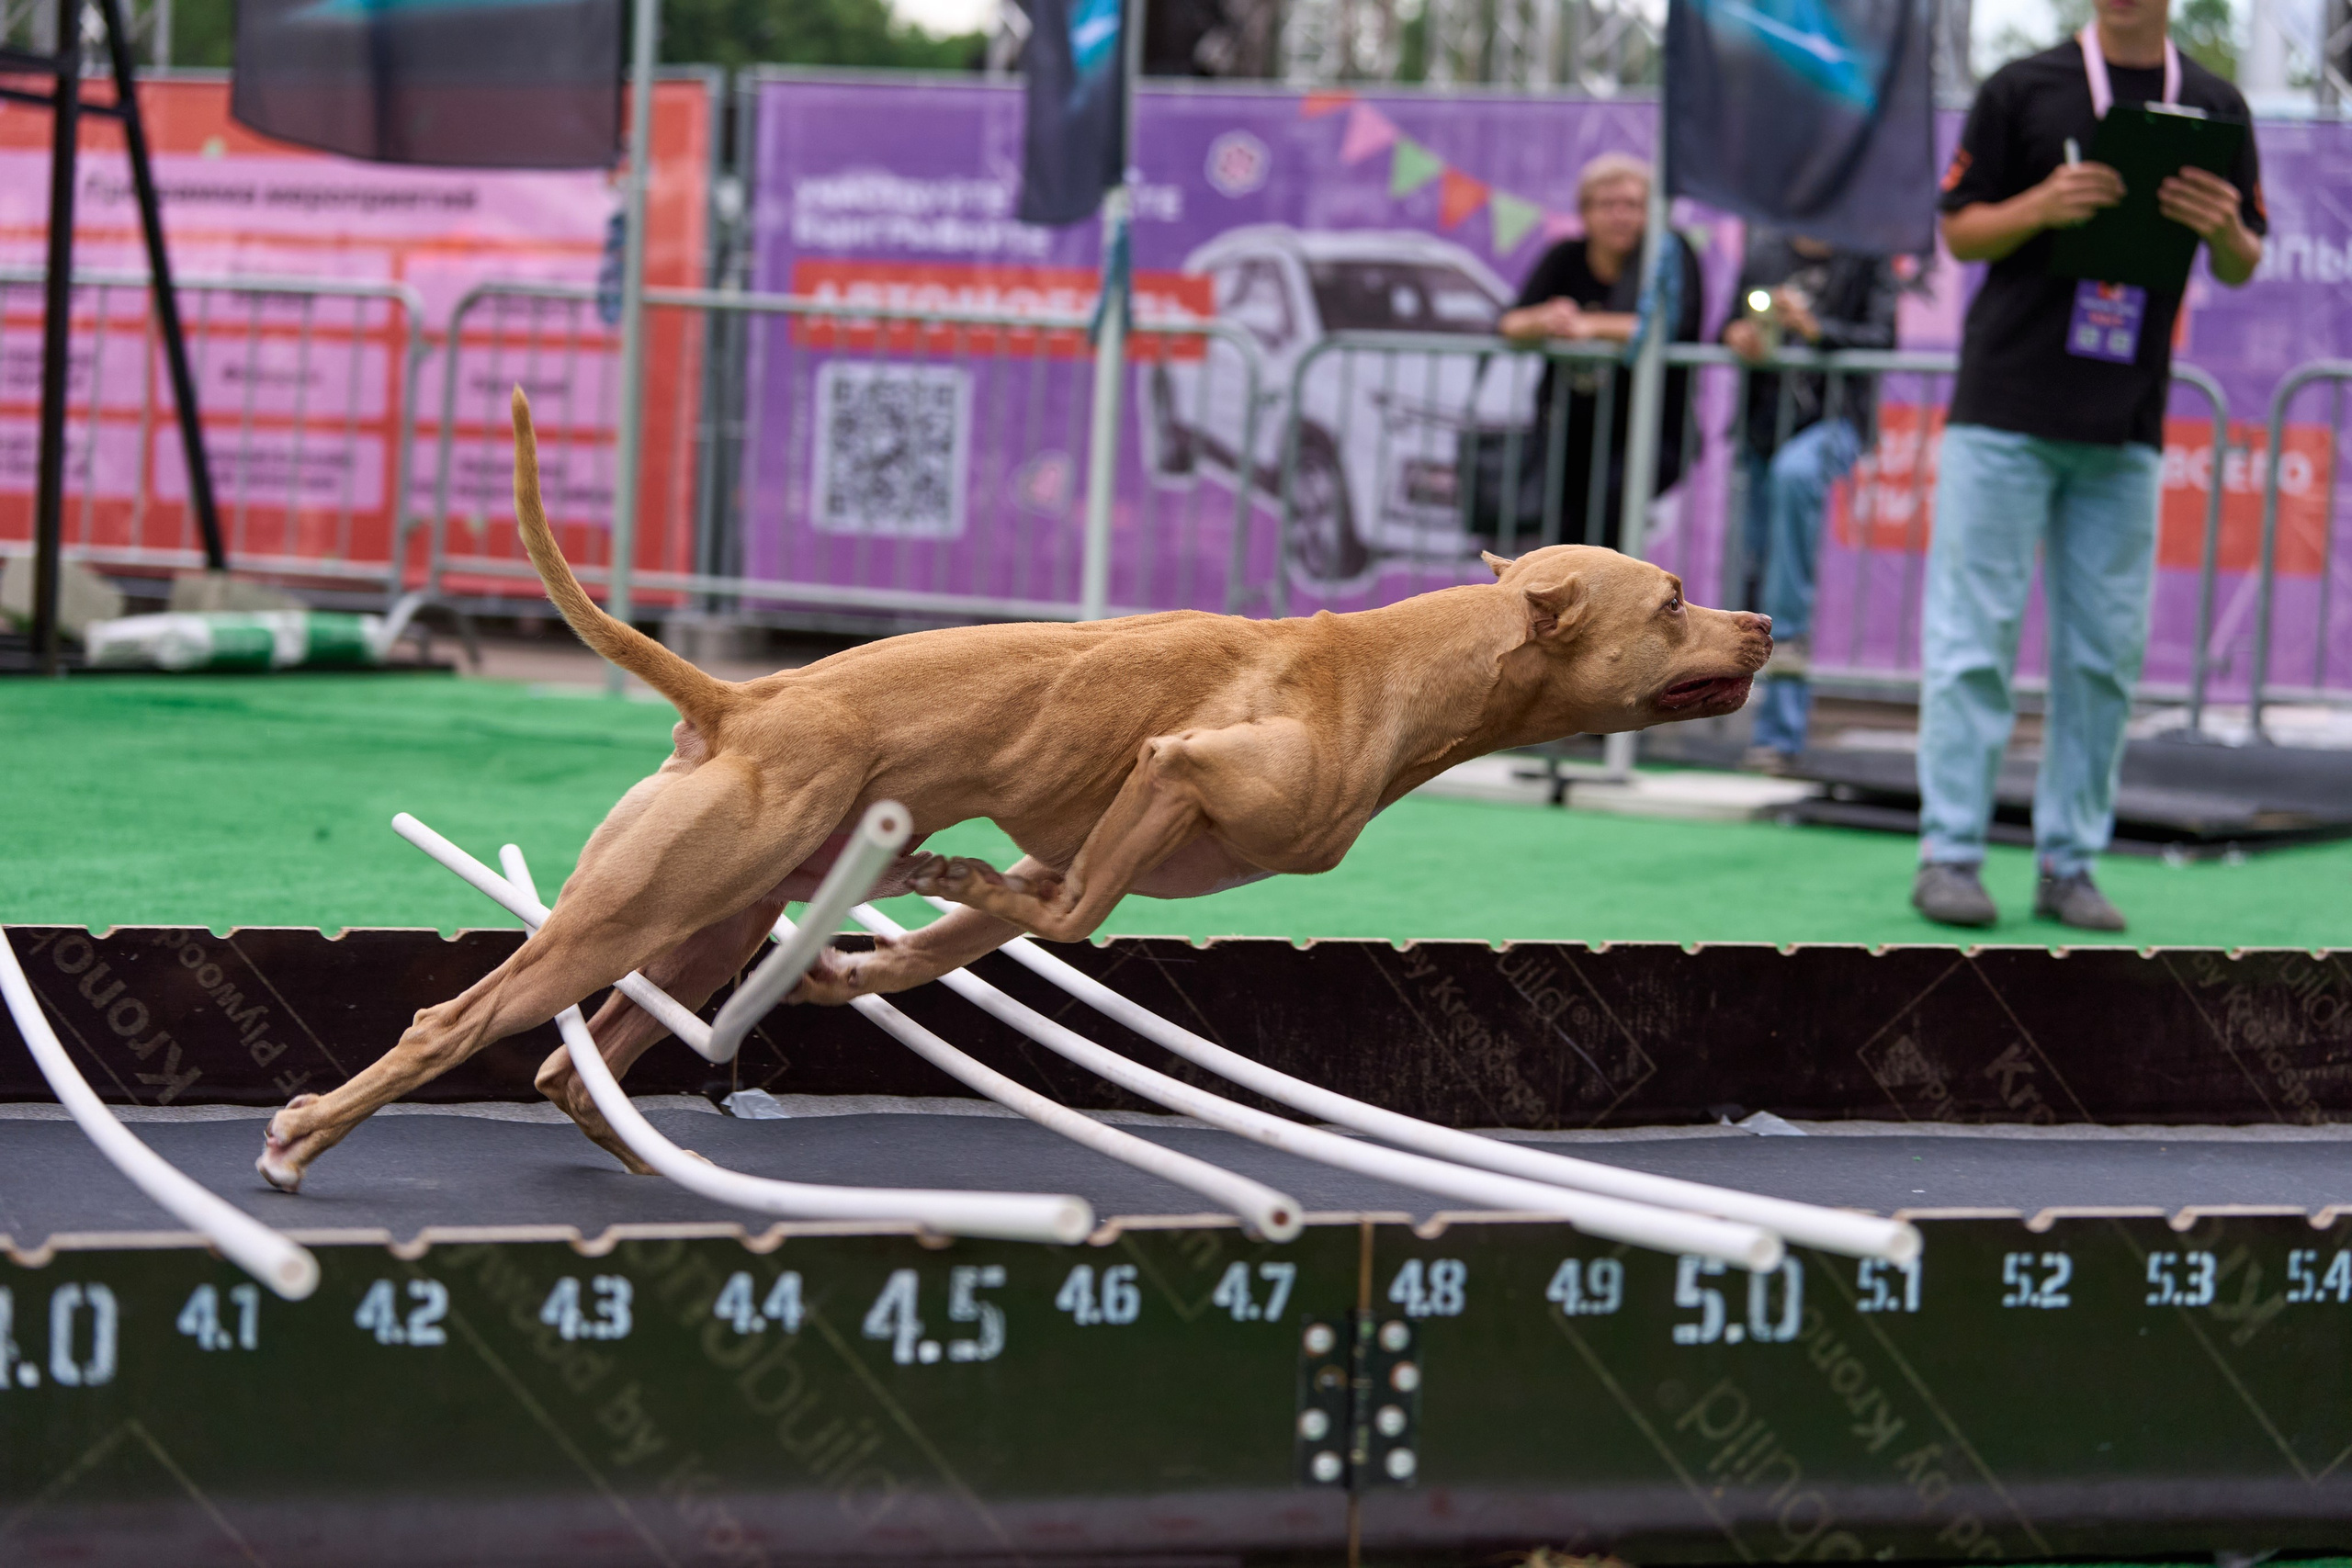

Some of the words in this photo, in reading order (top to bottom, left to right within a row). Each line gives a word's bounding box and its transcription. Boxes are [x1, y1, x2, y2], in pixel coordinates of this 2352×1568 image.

[714, 1270, 805, 1334] 4.4
[1055, 1264, 1140, 1325] 4.6
[1212, 1261, 1296, 1322] 4.7
[1388, 1258, 1466, 1316] 4.8
[1545, 1258, 1623, 1315] 4.9
[1672, 1255, 1804, 1345] 5.0
[1856, 1258, 1922, 1312] 5.1
[2002, 1252, 2073, 1309] 5.2
[2145, 1250, 2217, 1306] 5.3
[2286, 1248, 2352, 1303] 5.4
[177, 1282, 260, 1350] 4.1
[355, 1279, 448, 1347] 4.2
[540, 1275, 633, 1341] 4.3
[862, 1266, 1006, 1364] 4.5
